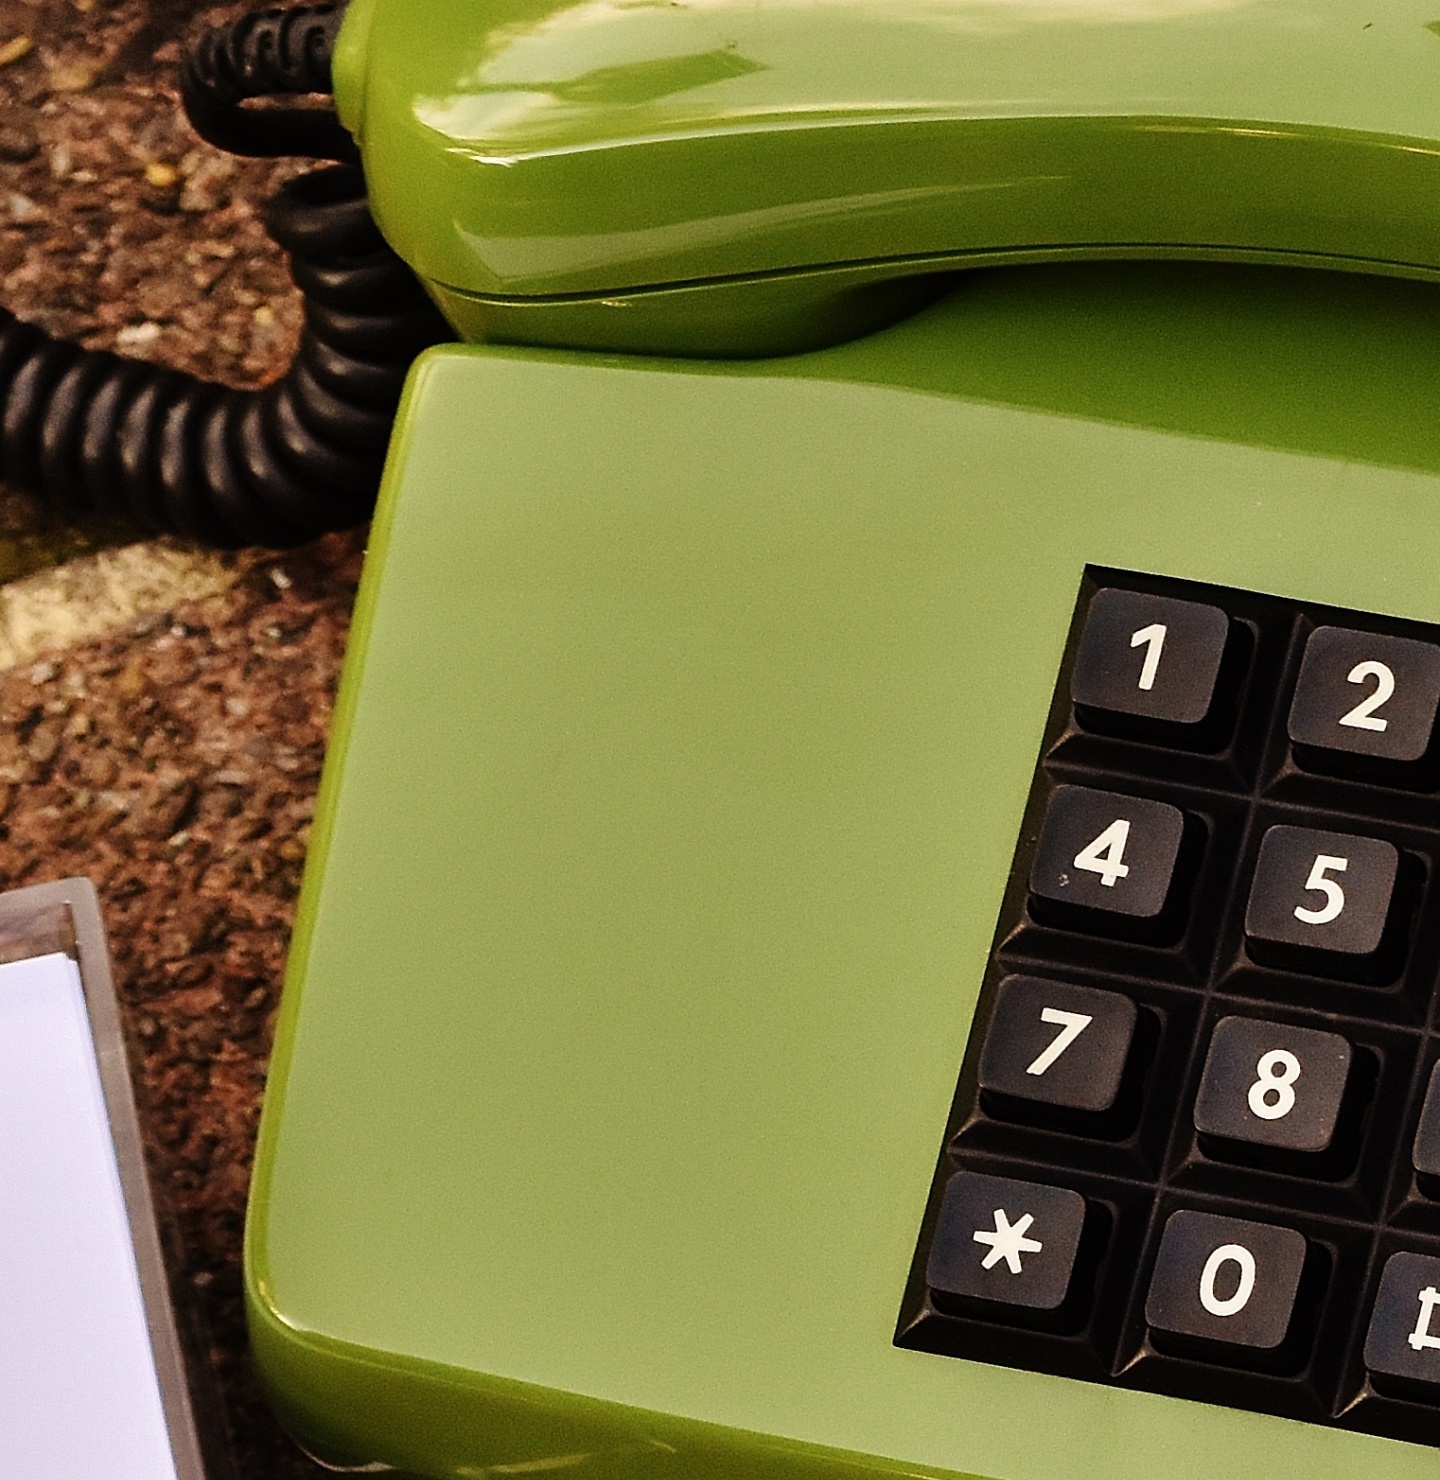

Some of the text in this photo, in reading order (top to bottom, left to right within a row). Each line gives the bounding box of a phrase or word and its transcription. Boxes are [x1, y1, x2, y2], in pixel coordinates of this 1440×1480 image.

[1131, 624, 1166, 690] 1
[1338, 660, 1395, 732] 2
[1073, 819, 1131, 887] 4
[1293, 854, 1348, 925] 5
[1026, 1007, 1093, 1076] 7
[1247, 1049, 1301, 1120] 8
[1199, 1243, 1256, 1317] 0
